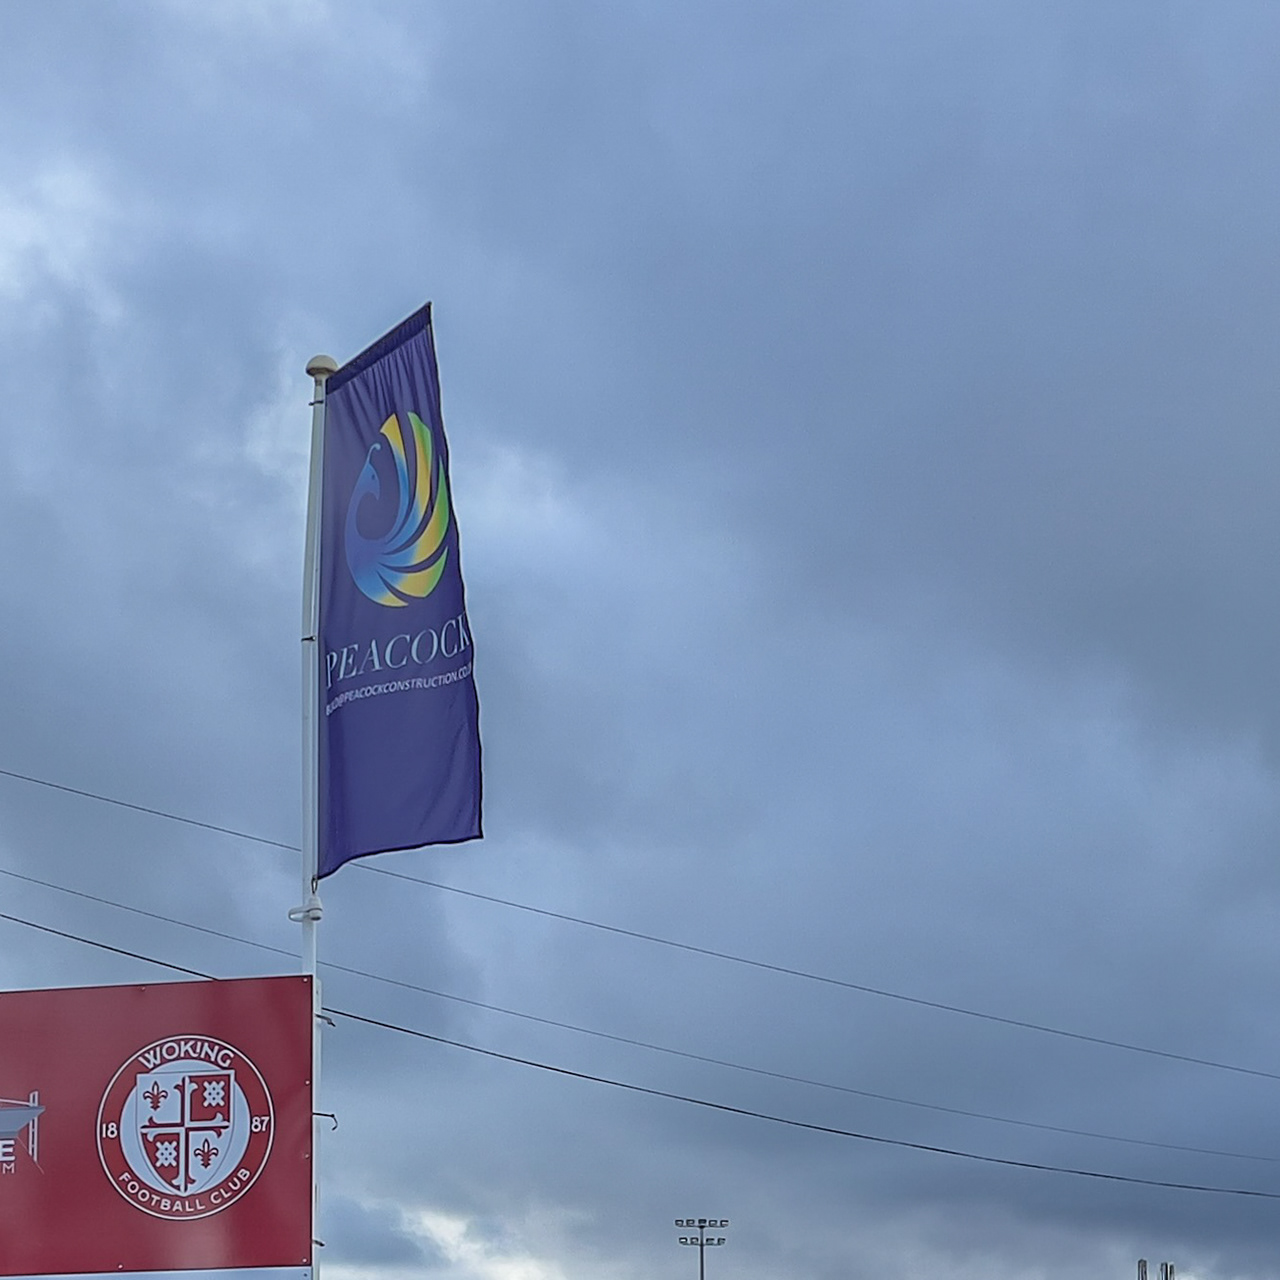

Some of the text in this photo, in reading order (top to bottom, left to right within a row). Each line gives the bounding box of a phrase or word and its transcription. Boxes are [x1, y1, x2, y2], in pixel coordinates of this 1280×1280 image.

[326, 612, 470, 689] PEACOCK
[137, 1040, 234, 1069] WOKING
[102, 1122, 118, 1138] 18
[251, 1116, 269, 1133] 87
[119, 1168, 251, 1212] FOOTBALL CLUB
